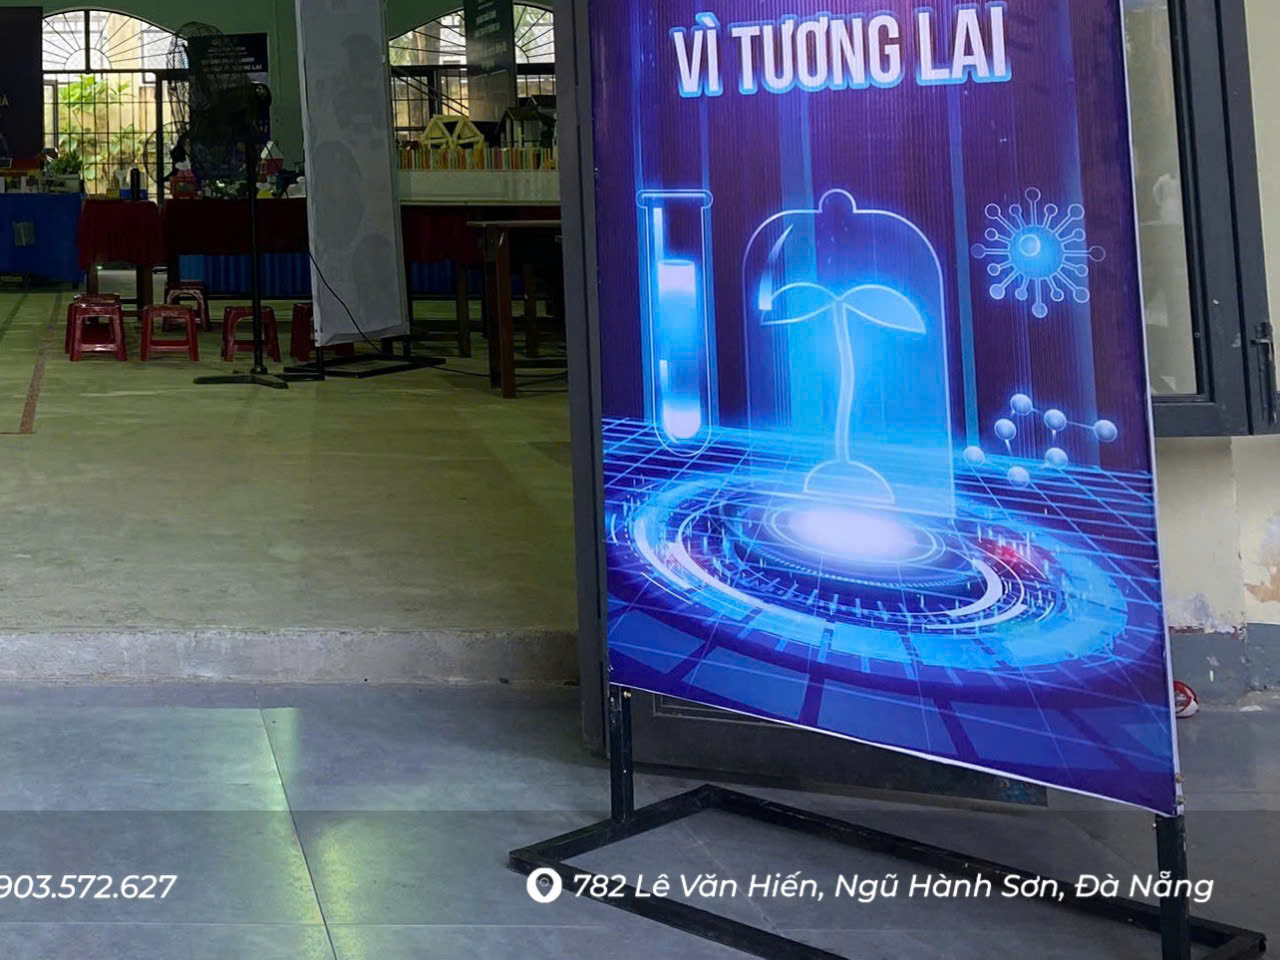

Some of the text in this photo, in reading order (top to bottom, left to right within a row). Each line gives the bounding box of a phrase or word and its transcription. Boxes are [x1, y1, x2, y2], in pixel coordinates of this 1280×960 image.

[670, 2, 1011, 97] VÌ TƯƠNG LAI
